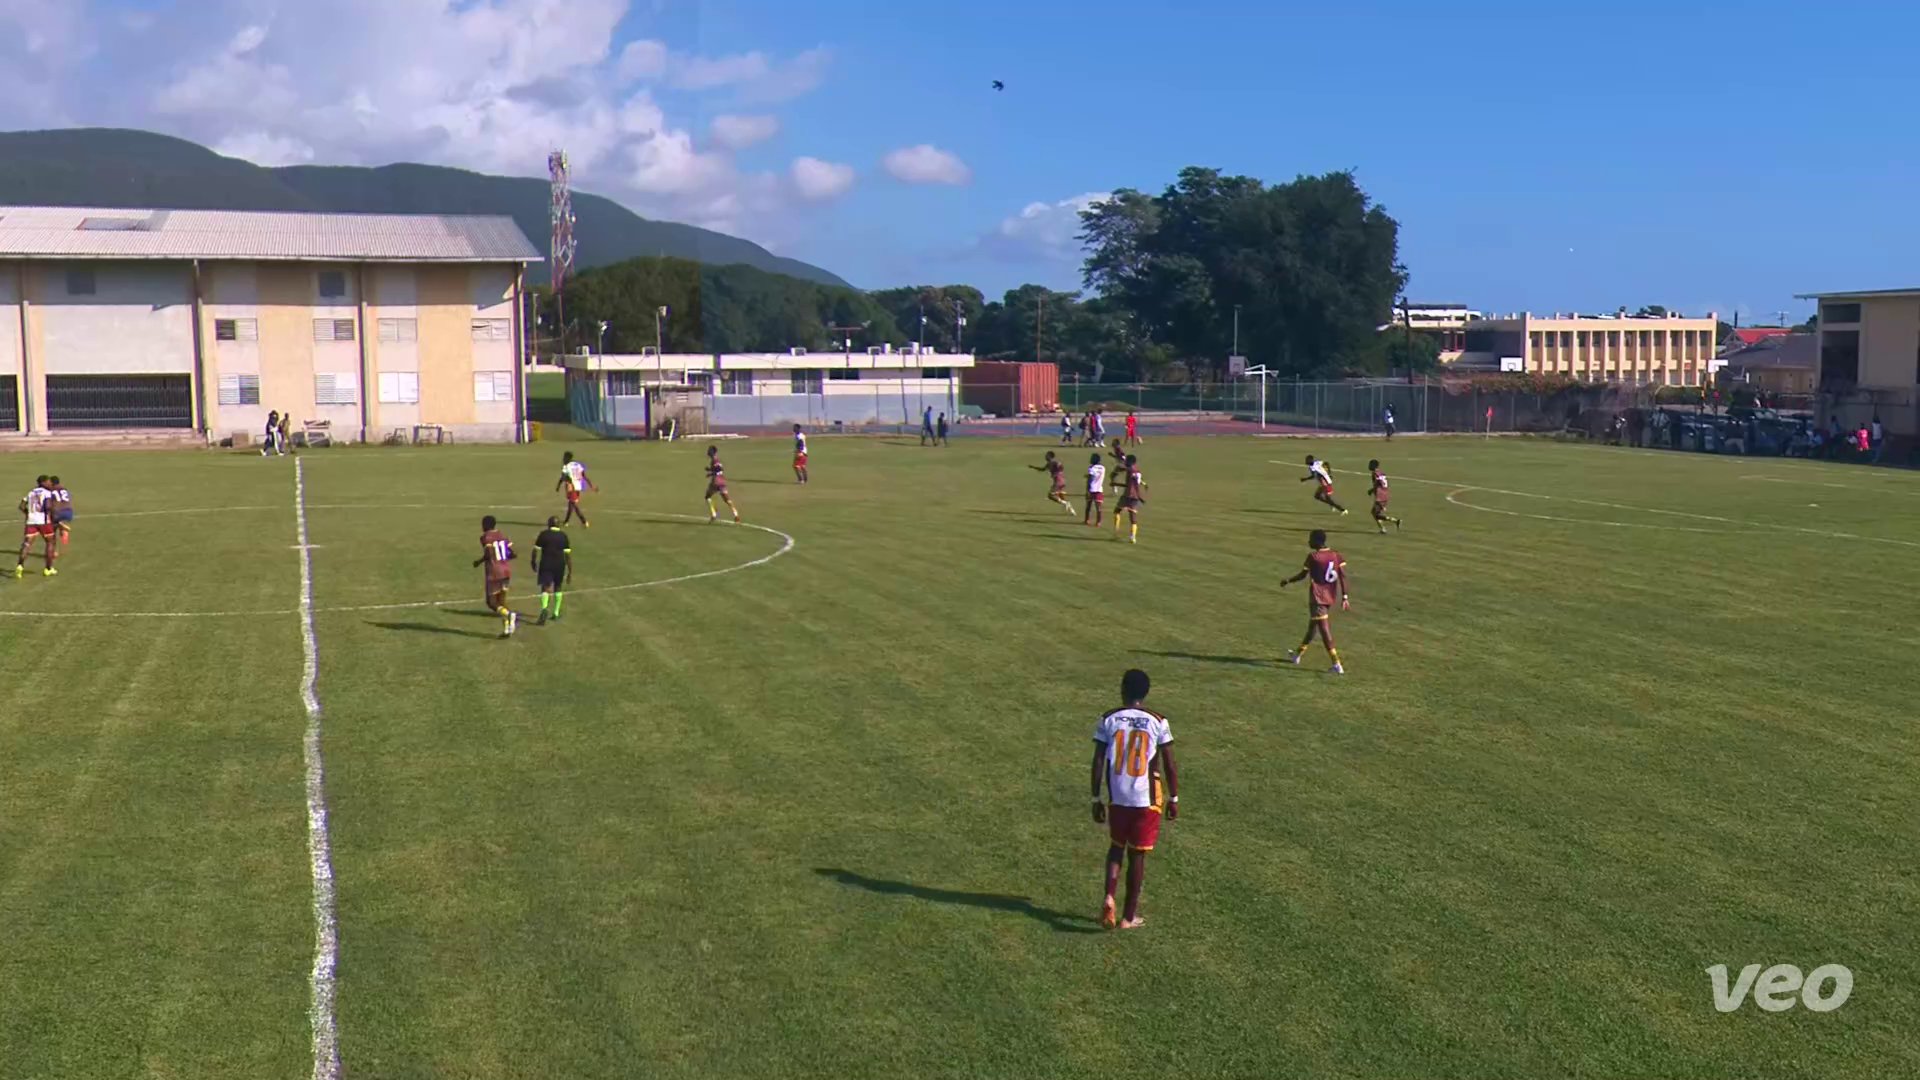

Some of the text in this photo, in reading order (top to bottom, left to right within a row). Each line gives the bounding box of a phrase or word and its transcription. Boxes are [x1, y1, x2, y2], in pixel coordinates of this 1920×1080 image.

[52, 489, 70, 503] 12
[492, 540, 508, 562] 11
[1324, 560, 1339, 584] 6
[1113, 728, 1150, 778] 18
